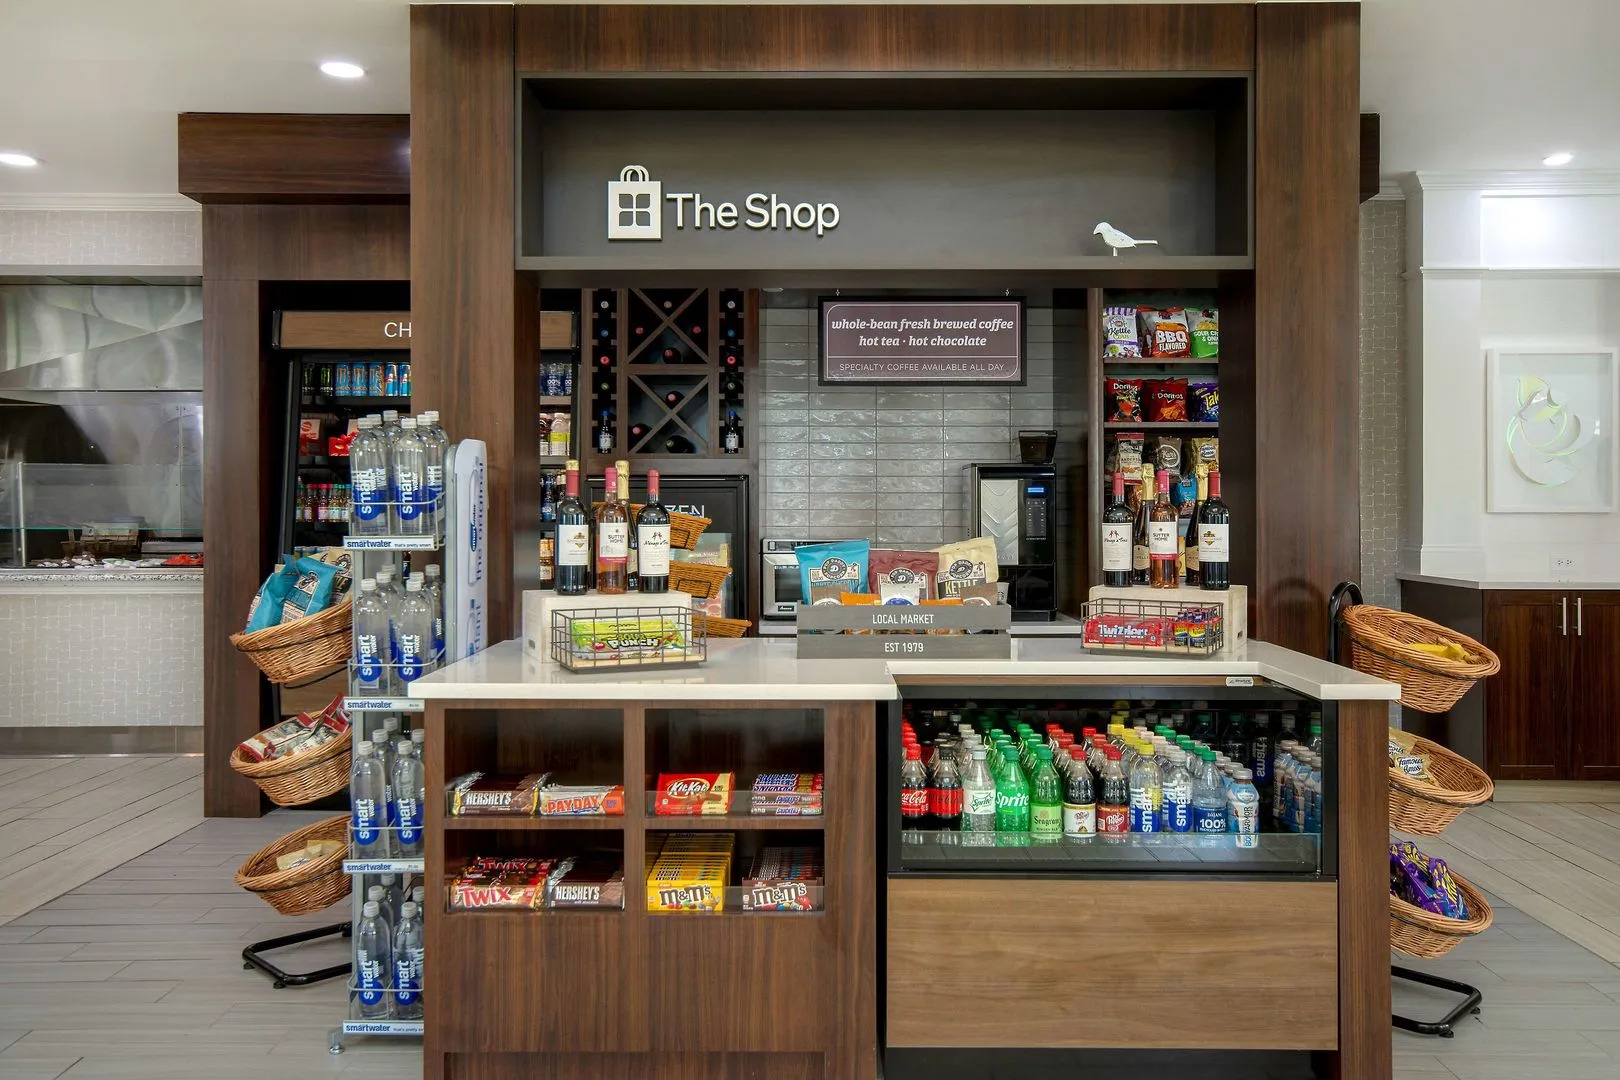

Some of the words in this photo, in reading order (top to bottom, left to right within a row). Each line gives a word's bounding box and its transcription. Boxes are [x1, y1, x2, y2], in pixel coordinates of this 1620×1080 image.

[666, 193, 738, 230] The
[745, 193, 840, 238] Shop
[831, 319, 898, 330] whole-bean
[898, 318, 931, 332] fresh
[933, 318, 977, 330] brewed
[978, 318, 1014, 332] coffee
[1107, 326, 1131, 336] Kettle
[858, 335, 879, 346] hot
[881, 337, 900, 346] tea
[908, 335, 928, 346] hot
[930, 335, 987, 346] chocolate
[1155, 330, 1188, 344] BBQ
[1159, 341, 1187, 352] FLAVORED
[839, 363, 885, 371] SPECIALTY
[887, 363, 919, 371] COFFEE
[921, 363, 968, 371] AVAILABLE
[969, 363, 985, 371] ALL
[987, 363, 1005, 371] DAY
[1113, 382, 1138, 391] Doritos
[1157, 392, 1184, 400] Doritos
[401, 471, 413, 514] smart
[346, 539, 392, 548] smartwater
[872, 614, 898, 625] LOCAL
[900, 614, 935, 625] MARKET
[370, 634, 378, 654] water
[412, 634, 420, 654] water
[606, 638, 660, 650] PUNCH
[884, 642, 899, 652] EST
[901, 642, 924, 652] 1979
[358, 634, 373, 677] smart
[401, 634, 414, 676] smart
[347, 701, 393, 709] smartwater
[465, 792, 512, 806] HERSHEY'S
[547, 795, 599, 814] PAYDAY
[996, 791, 1030, 808] Sprite
[1176, 783, 1187, 827] smart
[367, 798, 376, 818] water
[409, 797, 417, 818] water
[1142, 790, 1153, 833] smart
[356, 798, 371, 840] smart
[398, 797, 413, 839] smart
[1199, 818, 1227, 829] 100%
[346, 862, 392, 871] smartwater
[555, 885, 600, 901] HERSHEY'S
[752, 883, 807, 907] m&m's
[362, 959, 375, 1000] smart
[399, 960, 411, 1000] smart
[345, 1024, 391, 1032] smartwater
